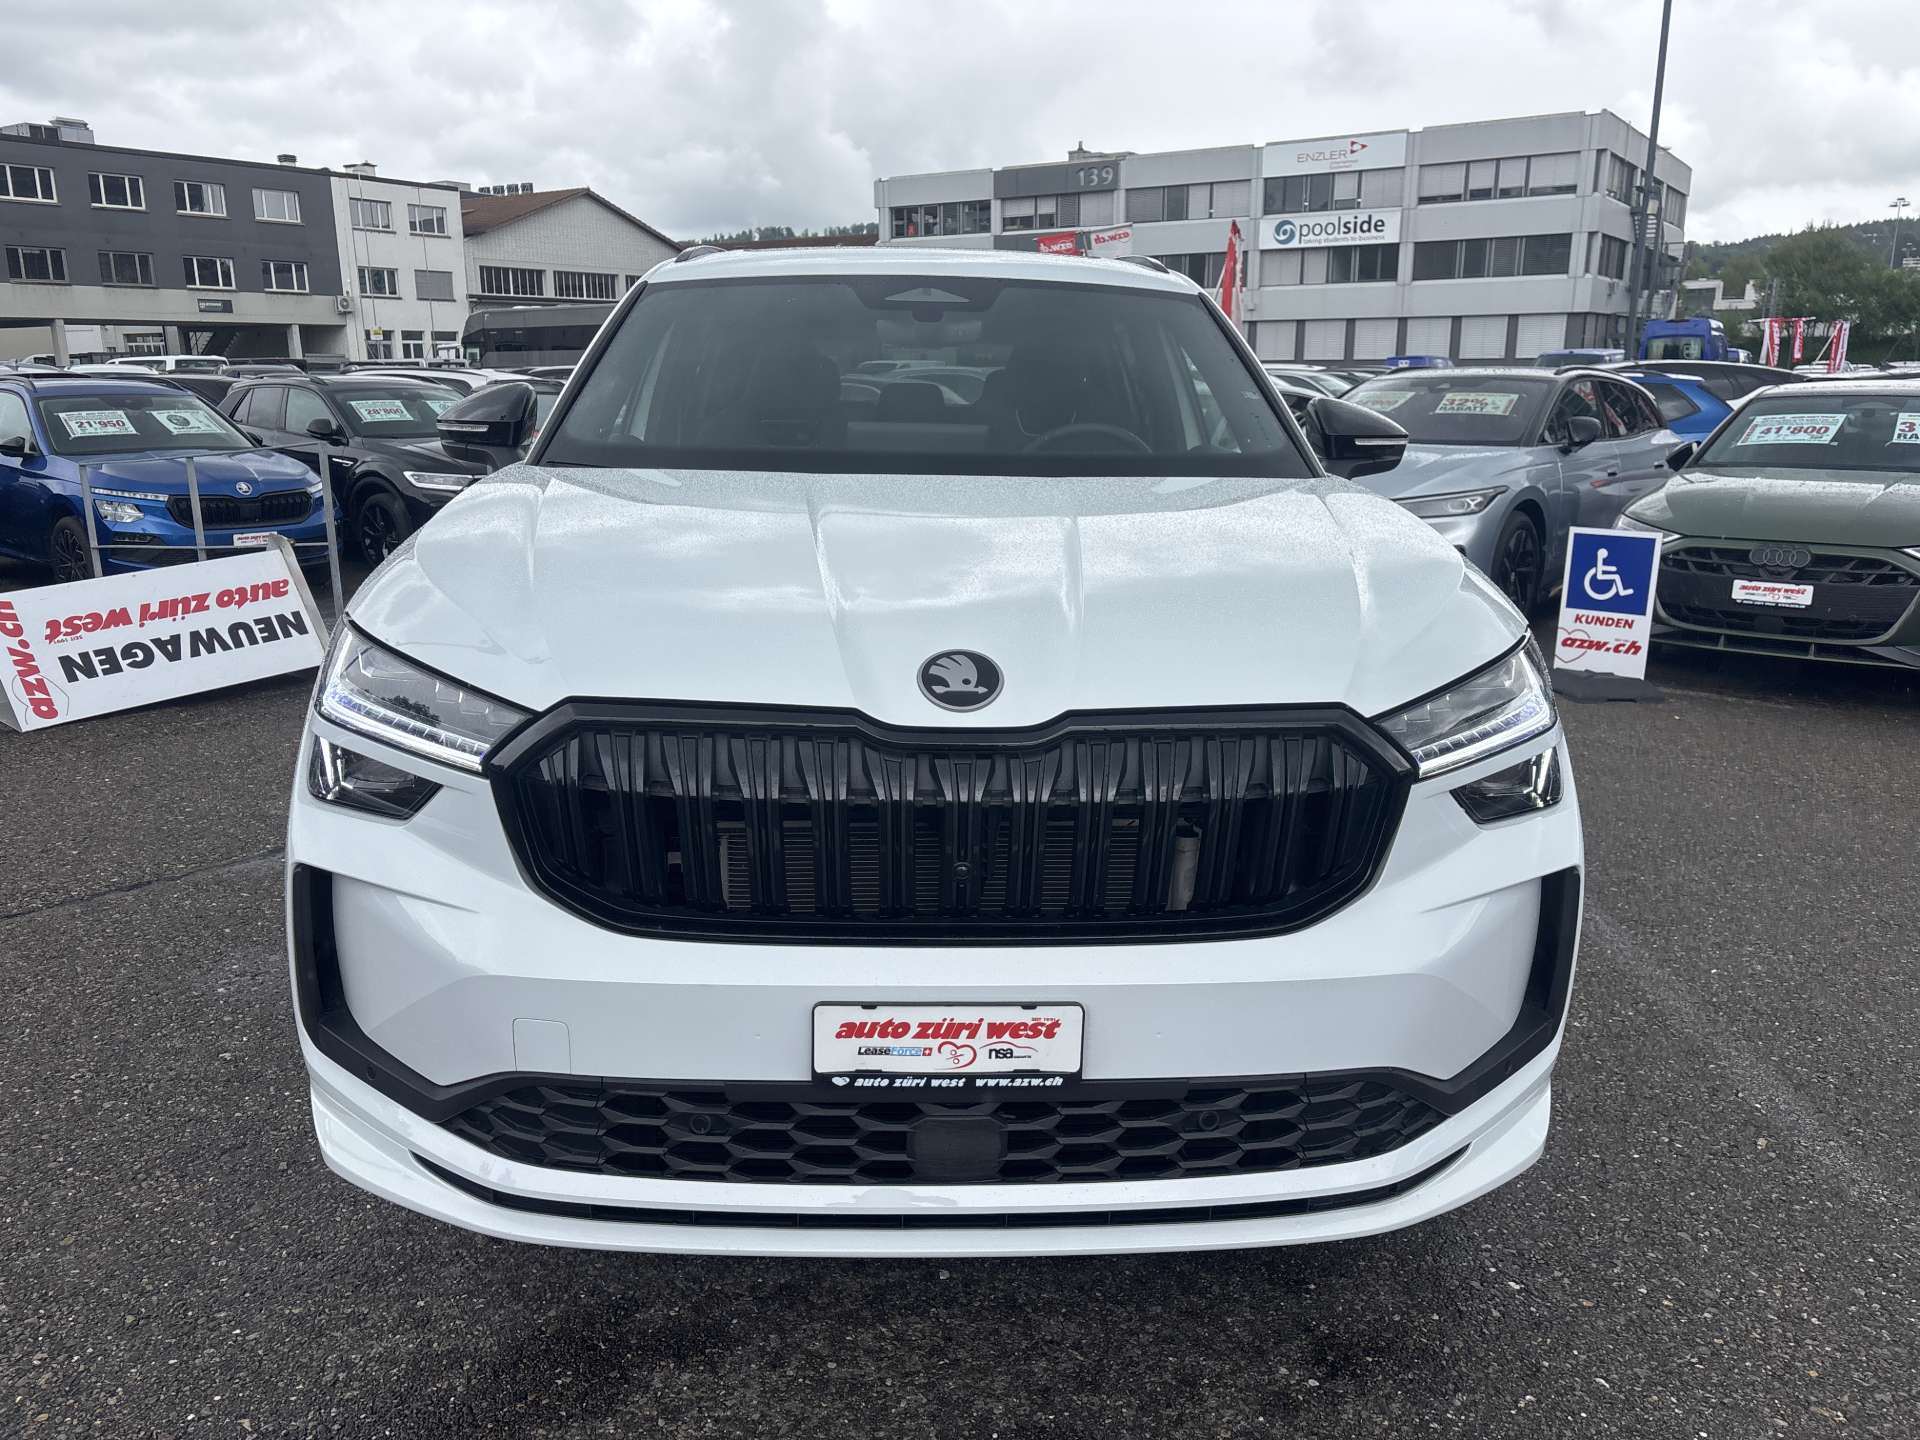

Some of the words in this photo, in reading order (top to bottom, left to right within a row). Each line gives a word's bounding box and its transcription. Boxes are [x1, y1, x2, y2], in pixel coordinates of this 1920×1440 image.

[1296, 149, 1348, 163] ENZLER
[1079, 167, 1113, 186] 139
[1299, 214, 1385, 244] poolside
[75, 419, 126, 429] 21'950
[1760, 425, 1830, 435] 41'800
[1899, 421, 1920, 432] 3
[216, 578, 289, 609] auto
[139, 592, 211, 628] züri
[45, 607, 133, 645] west
[1574, 614, 1635, 629] KUNDEN
[58, 610, 309, 683] NEUWAGEN
[1561, 637, 1642, 655] azw.ch
[835, 1018, 911, 1039] auto
[911, 1018, 985, 1039] züri
[987, 1019, 1061, 1039] west
[988, 1048, 1014, 1059] nsa
[854, 1077, 888, 1087] auto
[893, 1076, 927, 1087] züri
[930, 1077, 966, 1087] west
[975, 1076, 1063, 1087] www.azw.ch
